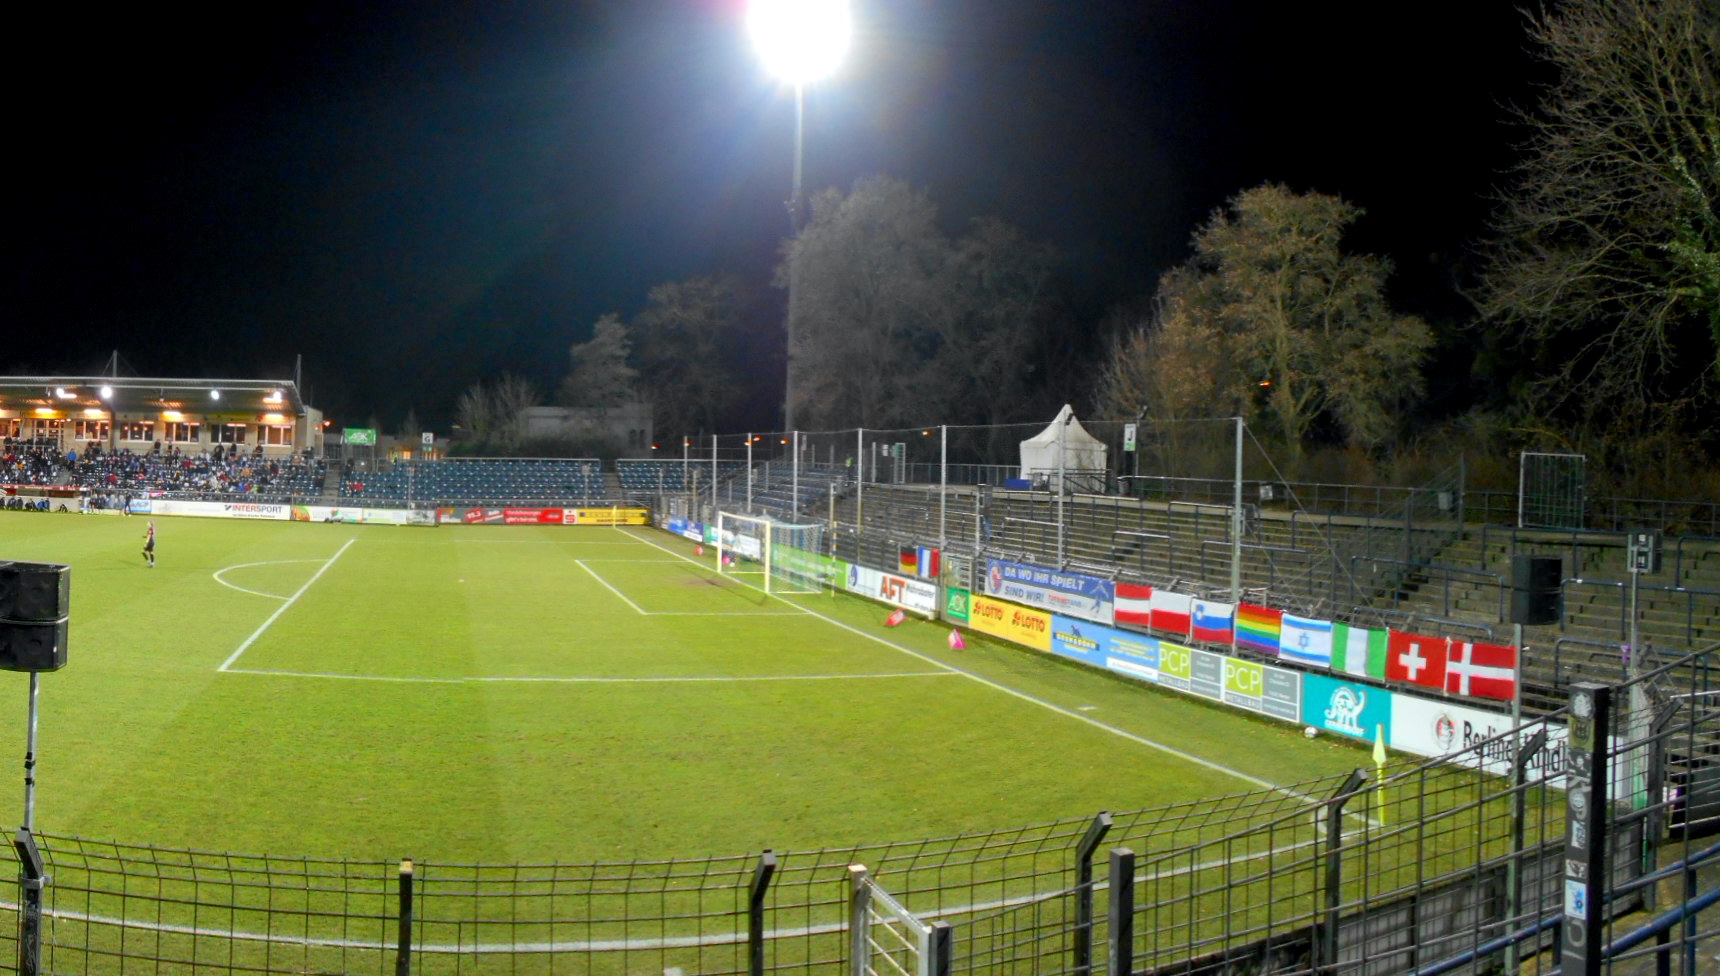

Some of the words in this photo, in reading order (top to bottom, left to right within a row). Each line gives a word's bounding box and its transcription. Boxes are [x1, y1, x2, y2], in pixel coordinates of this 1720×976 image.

[233, 503, 283, 513] INTERSPORT
[1004, 566, 1017, 578] DA
[1018, 568, 1032, 581] WO
[1033, 570, 1050, 584] IHR
[1050, 574, 1085, 591] SPIELT
[1004, 585, 1024, 599] SIND
[982, 603, 1005, 621] LOTTO
[1021, 614, 1045, 633] LOTTO
[1160, 647, 1190, 674] PCP
[1225, 663, 1261, 692] PCP
[1463, 719, 1520, 765] Berline
